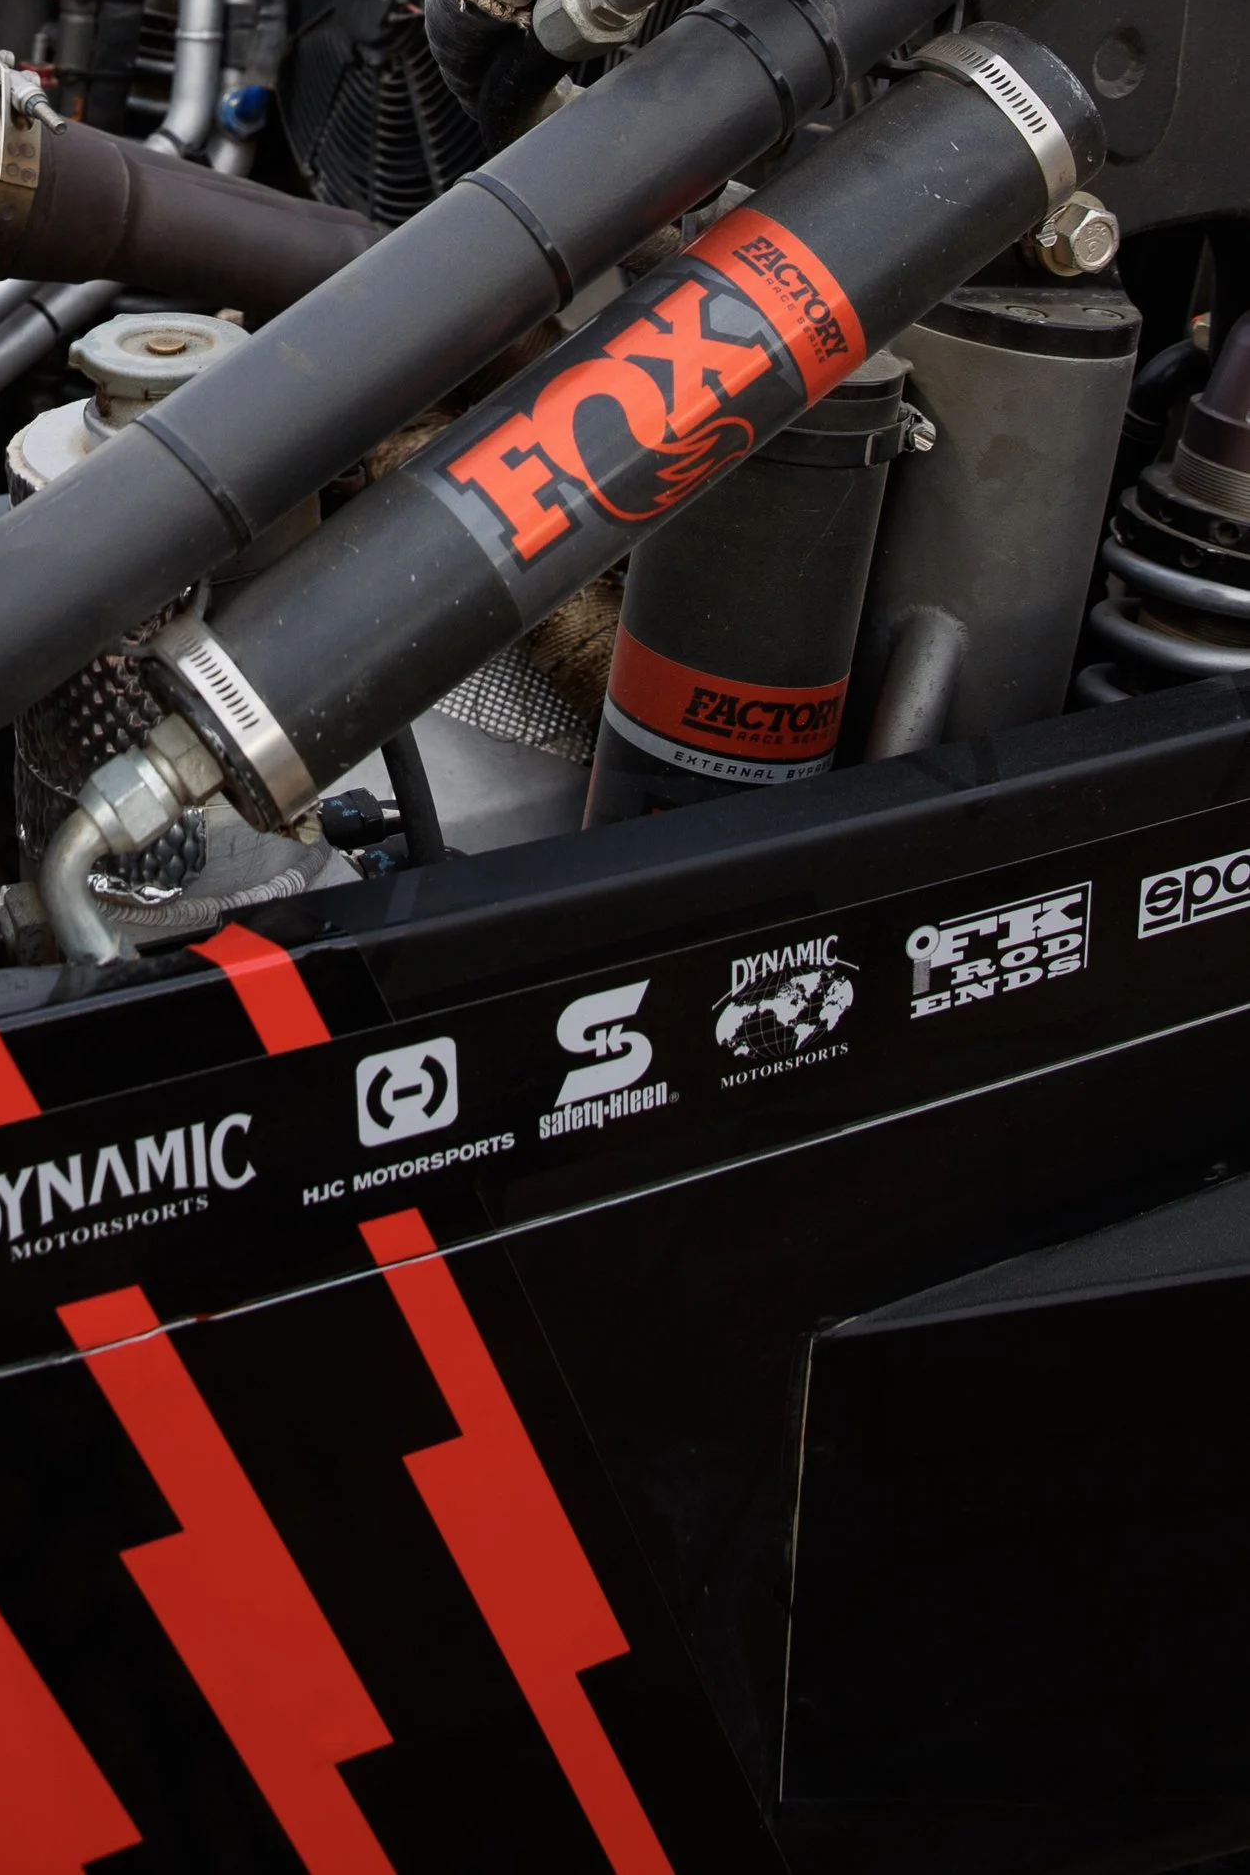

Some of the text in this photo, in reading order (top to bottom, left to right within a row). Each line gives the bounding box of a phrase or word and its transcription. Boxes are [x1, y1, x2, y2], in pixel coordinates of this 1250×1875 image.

[740, 236, 848, 357] FACTORY
[766, 278, 826, 364] RACE SERIES
[447, 280, 772, 561] FOX
[674, 751, 774, 779] EXTERNAL
[737, 731, 782, 744] RACE
[731, 935, 839, 997] DYNAMIC
[910, 953, 1081, 1019] ENDS
[951, 934, 1082, 985] ROD
[721, 1042, 849, 1089] MOTORSPORTS
[303, 1132, 516, 1206] HJC MOTORSPORTS
[10, 1194, 210, 1262] MOTORSPORTS
